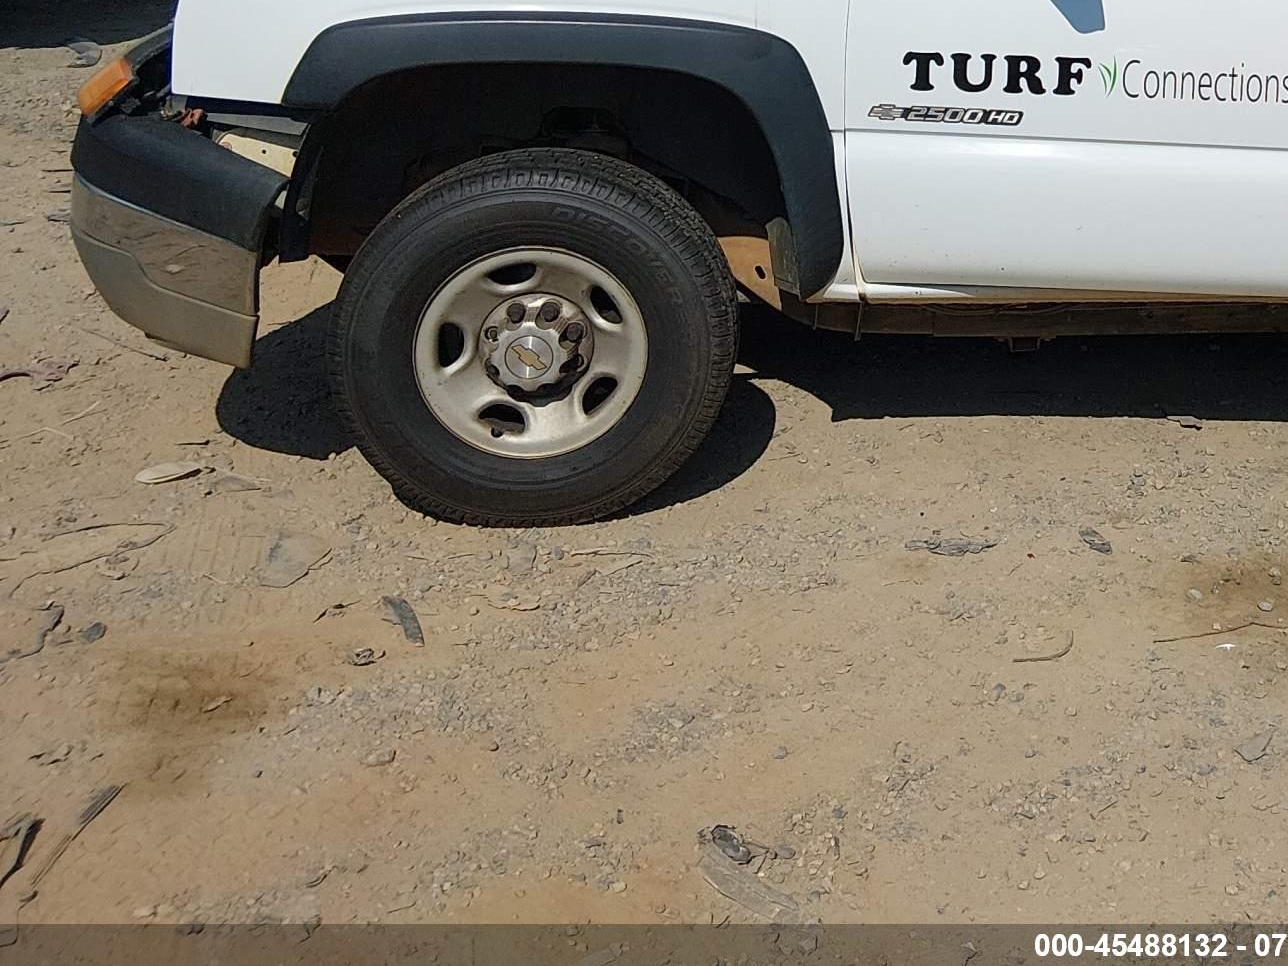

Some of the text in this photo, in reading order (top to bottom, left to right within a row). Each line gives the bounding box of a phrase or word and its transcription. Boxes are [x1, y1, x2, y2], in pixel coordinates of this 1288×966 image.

[902, 51, 1092, 96] TURF
[907, 105, 1020, 124] 2500 HD
